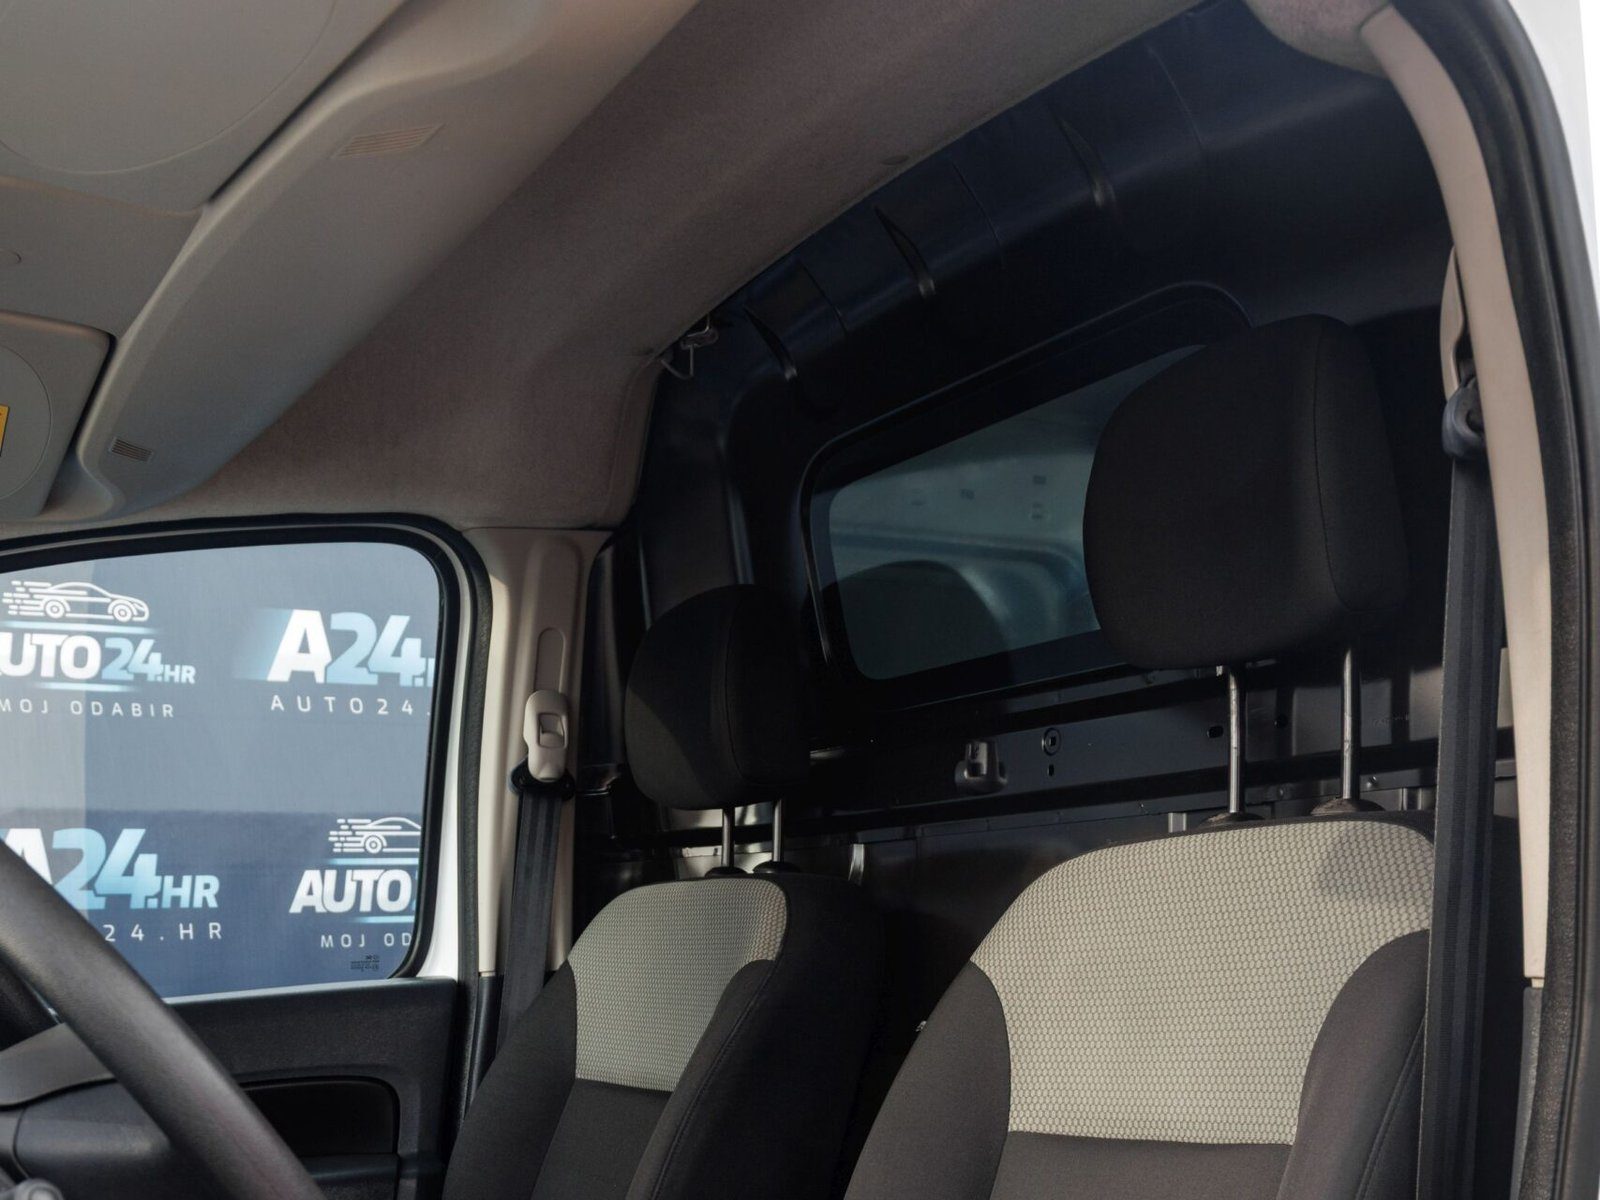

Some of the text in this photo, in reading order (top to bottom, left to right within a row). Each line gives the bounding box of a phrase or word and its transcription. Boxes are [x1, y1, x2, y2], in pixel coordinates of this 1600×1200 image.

[0, 632, 197, 684] UTO24.HR
[70, 700, 174, 718] ODABIR
[289, 869, 417, 913] AUTO
[320, 934, 366, 948] MOJ
